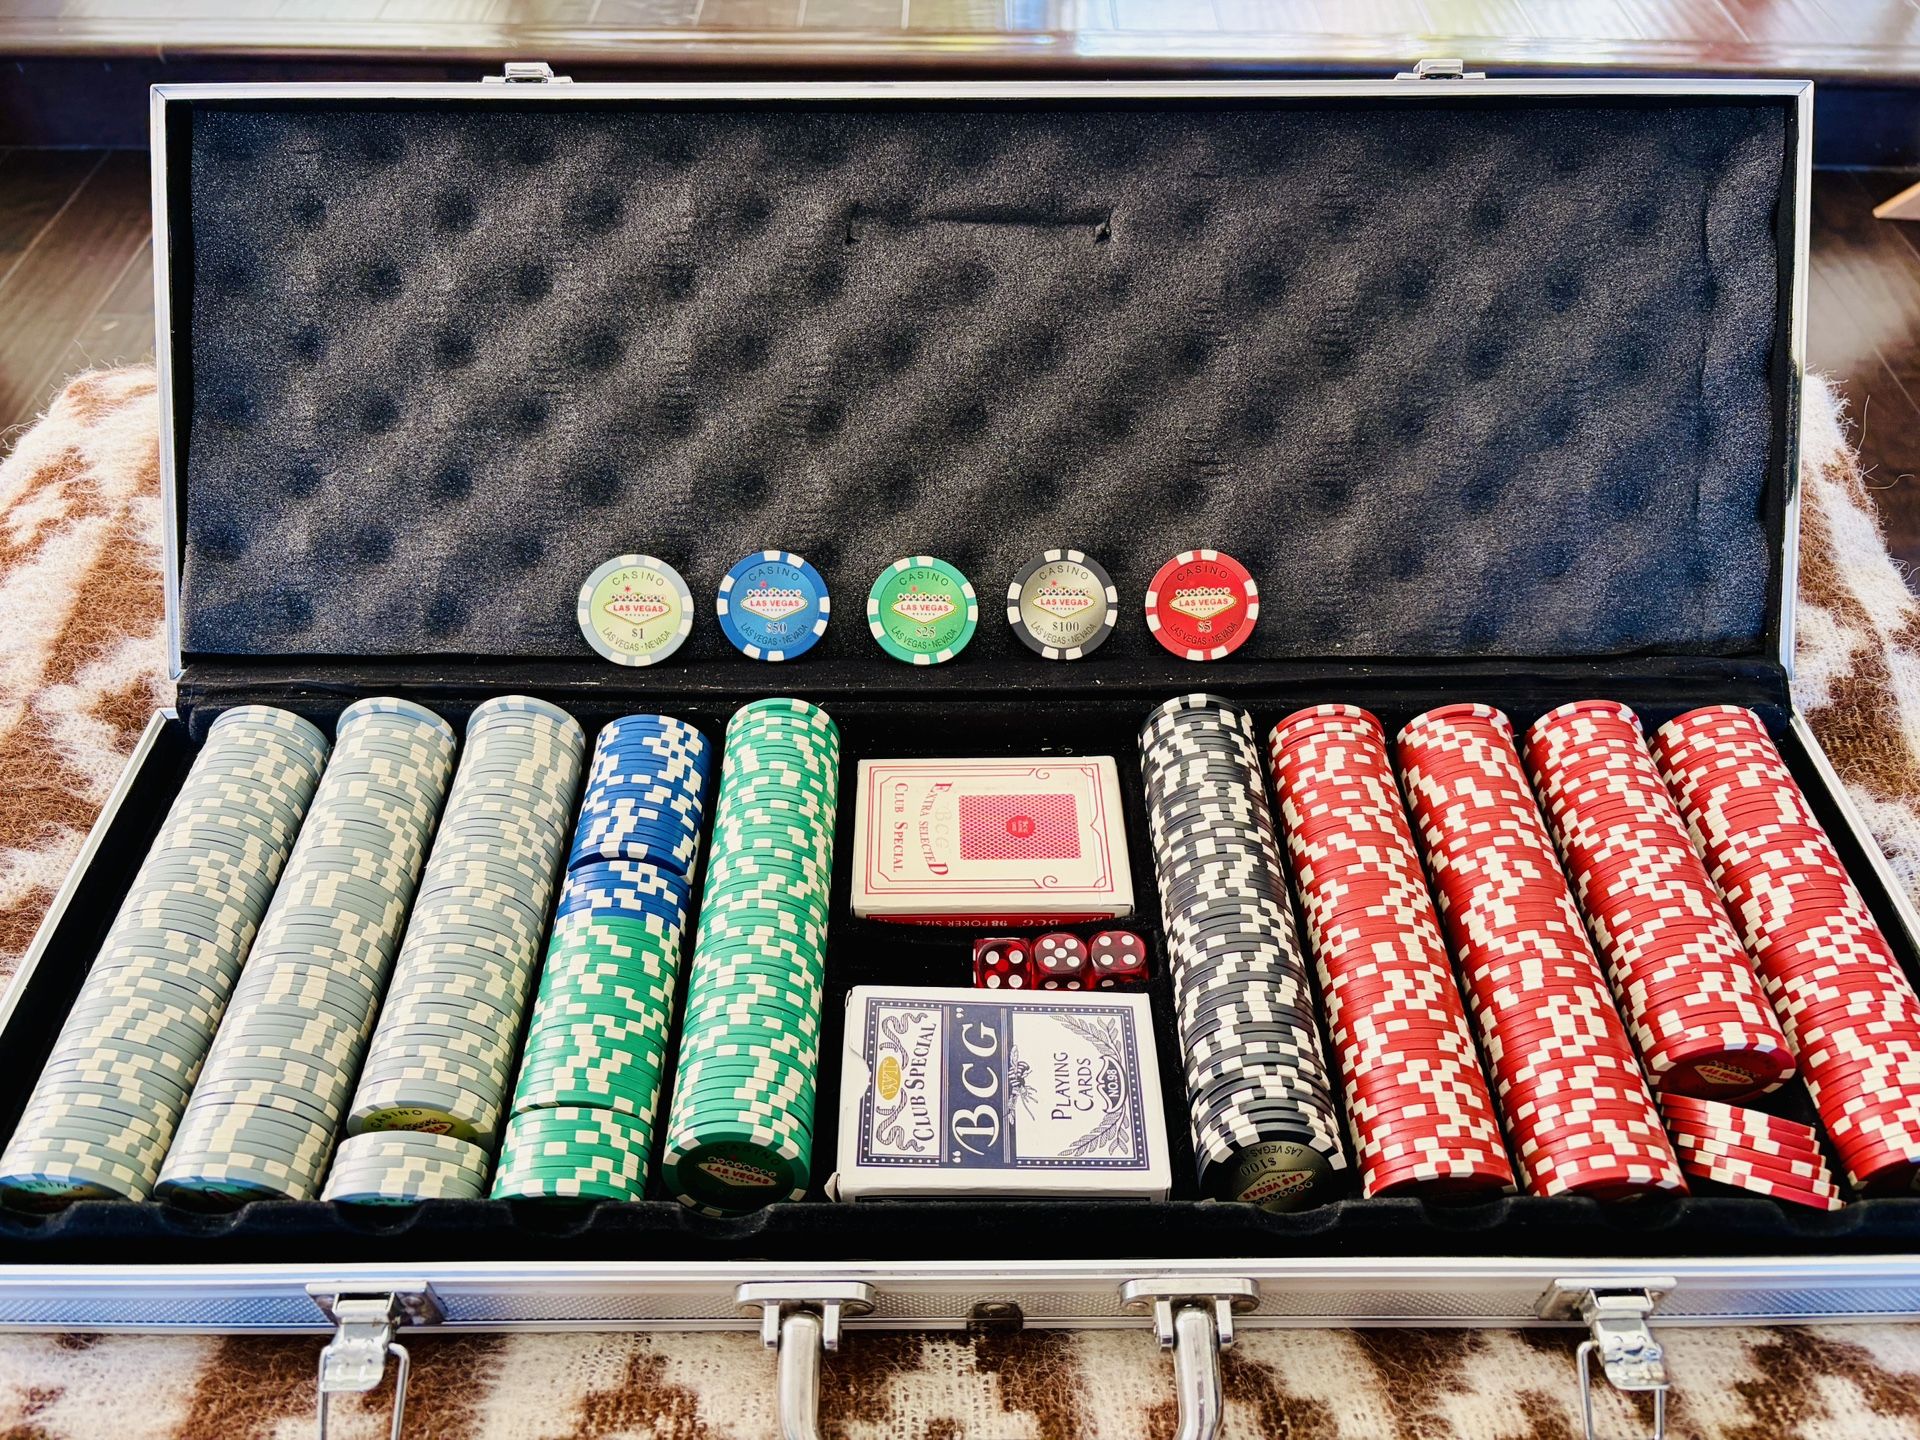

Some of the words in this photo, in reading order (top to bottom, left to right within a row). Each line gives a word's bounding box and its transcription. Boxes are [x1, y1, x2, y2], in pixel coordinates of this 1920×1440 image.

[612, 571, 664, 586] CASINO
[748, 566, 799, 581] CASINO
[898, 571, 949, 586] CASINO
[1038, 565, 1089, 580] CASINO
[1176, 565, 1228, 582] CASINO
[633, 605, 664, 613] VEGAS
[920, 604, 949, 612] VEGAS
[1199, 598, 1229, 606] VEGAS
[631, 628, 644, 639] $1
[741, 623, 754, 636] LAS
[753, 633, 778, 646] VEGAS
[783, 624, 808, 644] NEVADA
[766, 622, 787, 634] $50
[916, 627, 936, 637] $25
[1031, 621, 1043, 635] LAS
[1042, 632, 1067, 645] VEGAS
[1070, 623, 1097, 643] NEVADA
[1052, 621, 1080, 632] $100
[1170, 623, 1184, 637] LAS
[1183, 633, 1207, 646] VEGAS
[1211, 622, 1238, 643] NEVADA
[602, 627, 616, 641] LAS
[615, 638, 640, 652] VEGAS
[644, 630, 672, 650] NEVADA
[891, 626, 904, 639] LAS
[903, 637, 927, 650] VEGAS
[931, 628, 958, 648] NEVADA
[894, 783, 909, 813] CLUB
[920, 782, 953, 816] EXTRA
[893, 821, 909, 873] SPECIAL
[919, 821, 949, 875] SELECTED
[904, 1023, 937, 1090] SPECIAL
[1051, 1052, 1072, 1120] PLAYING
[1074, 1058, 1094, 1111] CARDS
[1106, 1069, 1119, 1097] NO.98
[370, 1109, 423, 1128] CASINO
[910, 1095, 935, 1141] CLUB
[1250, 1145, 1282, 1157] VEGAS
[1284, 1146, 1303, 1157] LAS
[707, 1165, 728, 1174] LAS
[732, 1170, 770, 1184] VEGAS
[1240, 1157, 1277, 1177] $100
[1282, 1173, 1304, 1186] LAS
[1243, 1182, 1281, 1200] VEGAS
